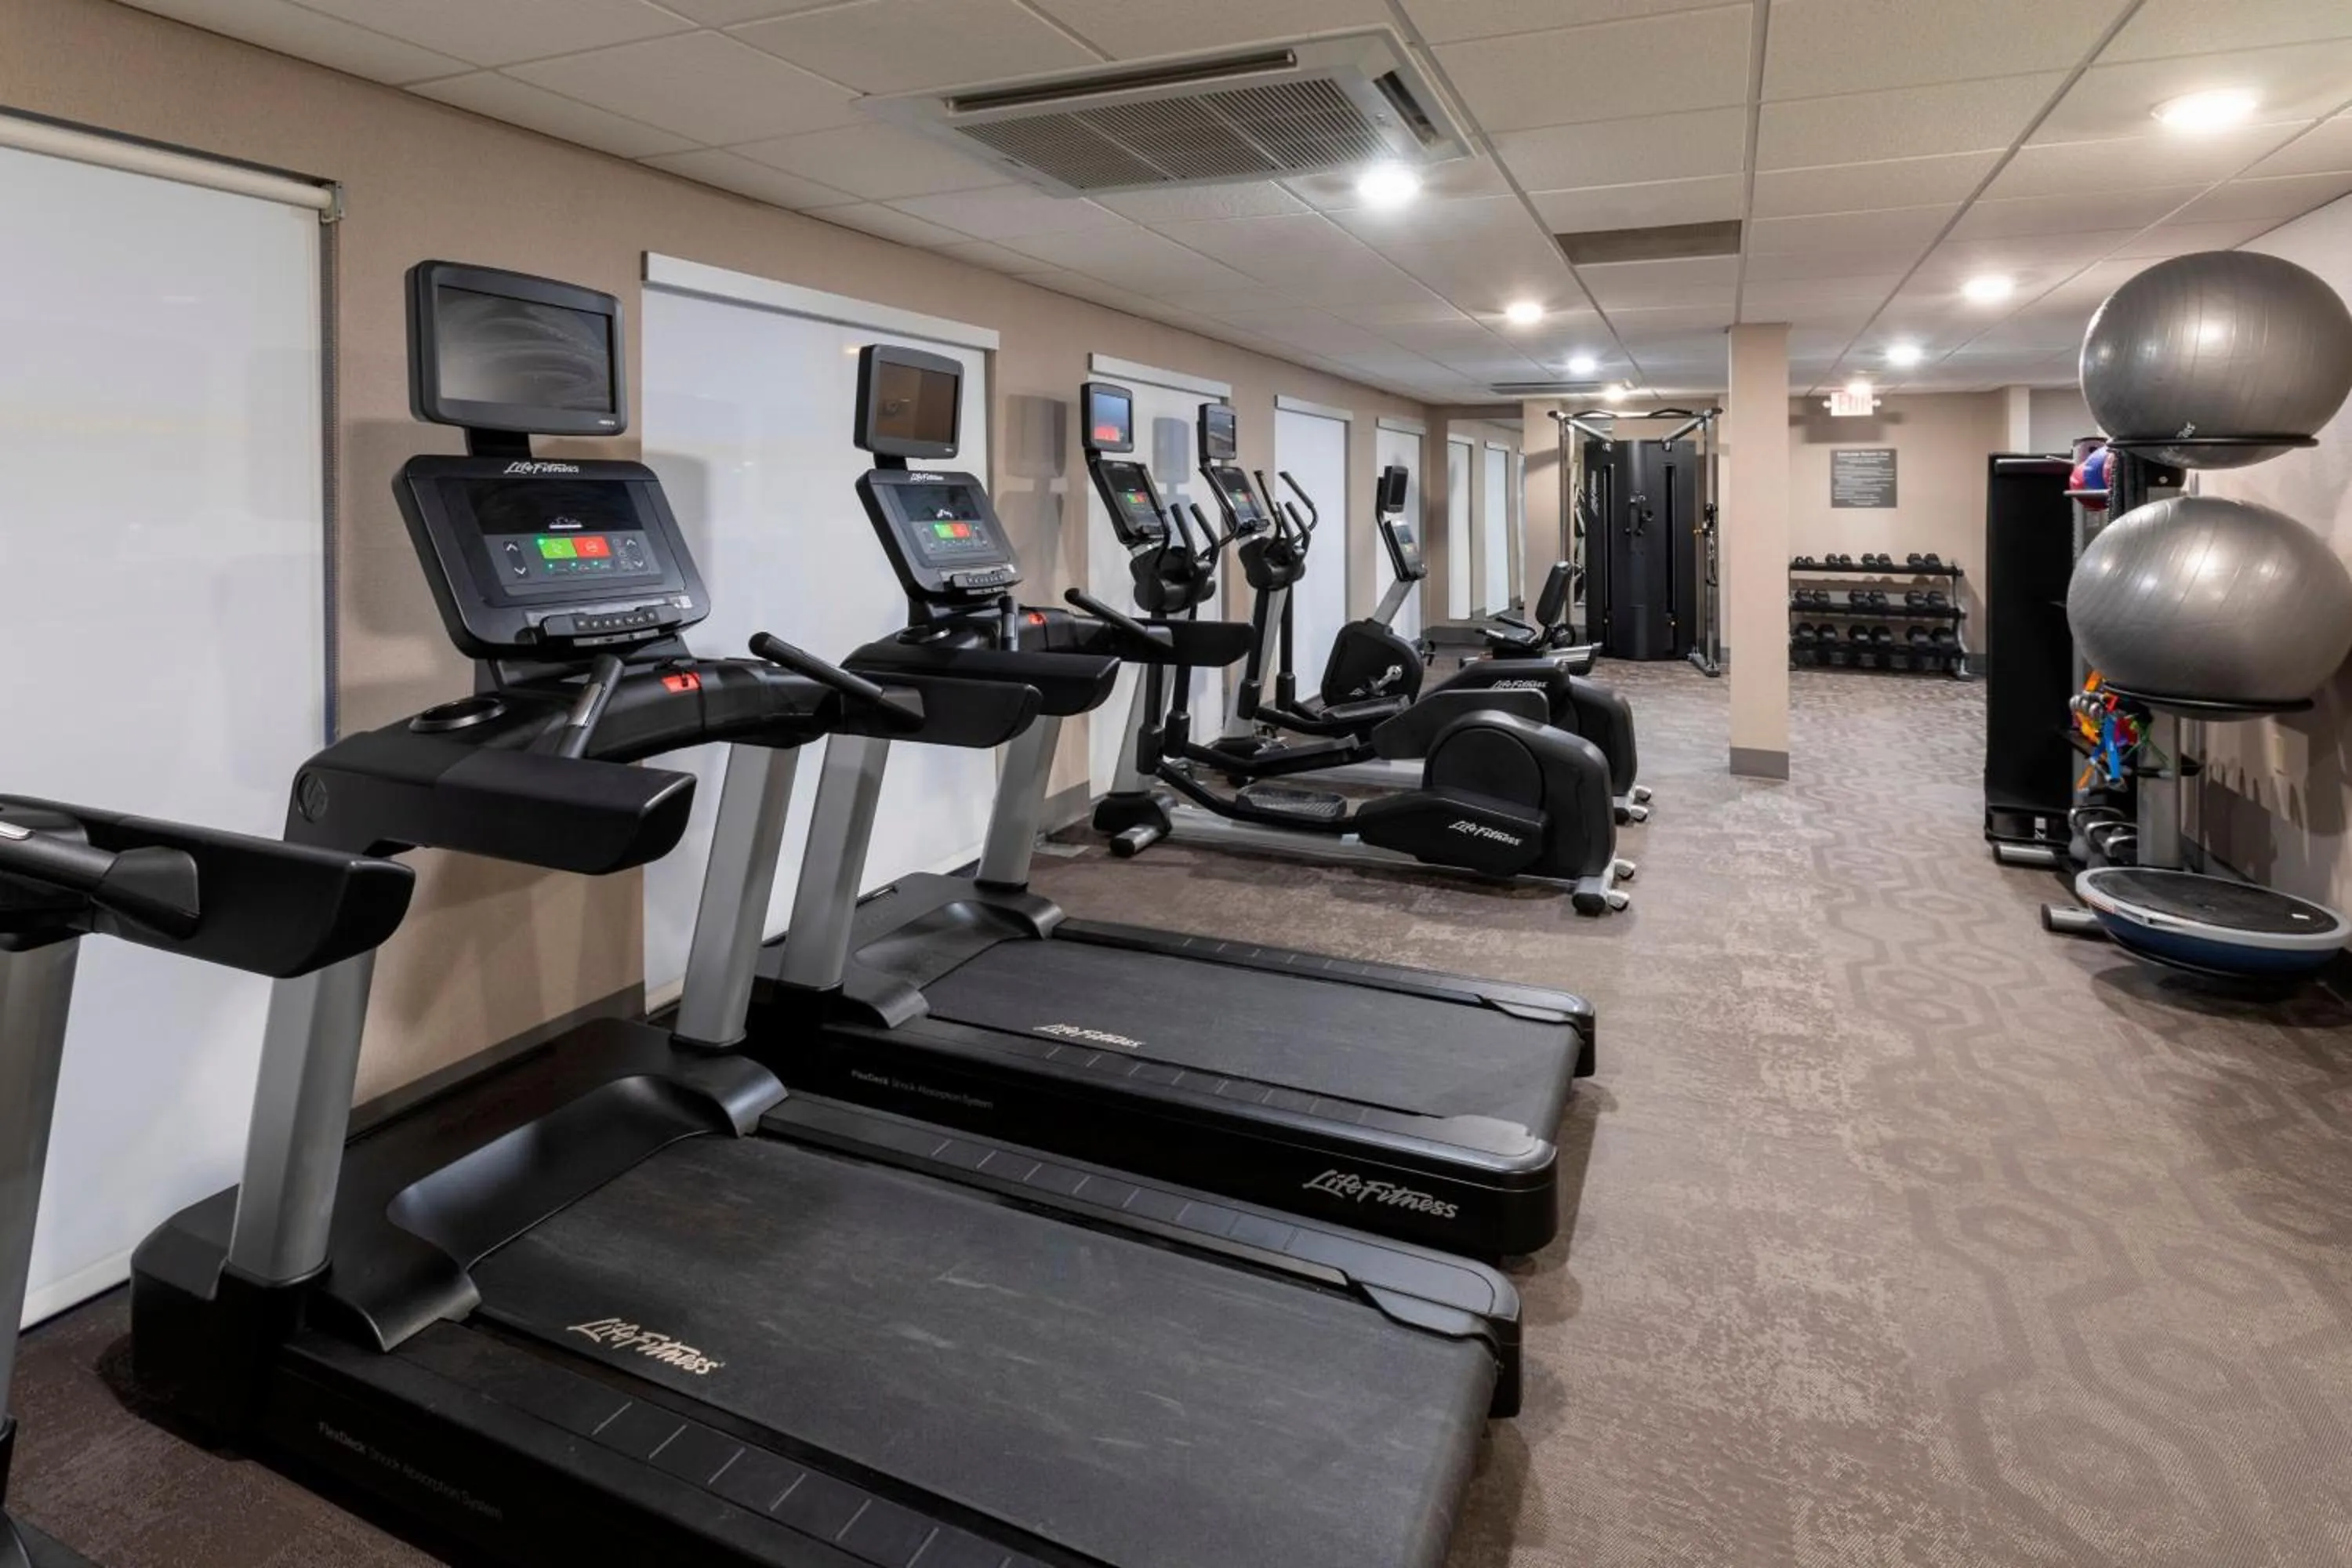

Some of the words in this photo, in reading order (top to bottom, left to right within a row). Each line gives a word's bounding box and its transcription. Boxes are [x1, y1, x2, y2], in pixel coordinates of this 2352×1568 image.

[1302, 1169, 1363, 1199] Life
[1356, 1180, 1459, 1218] Fitness
[566, 1317, 641, 1343] Life
[612, 1331, 718, 1374] Fitness
